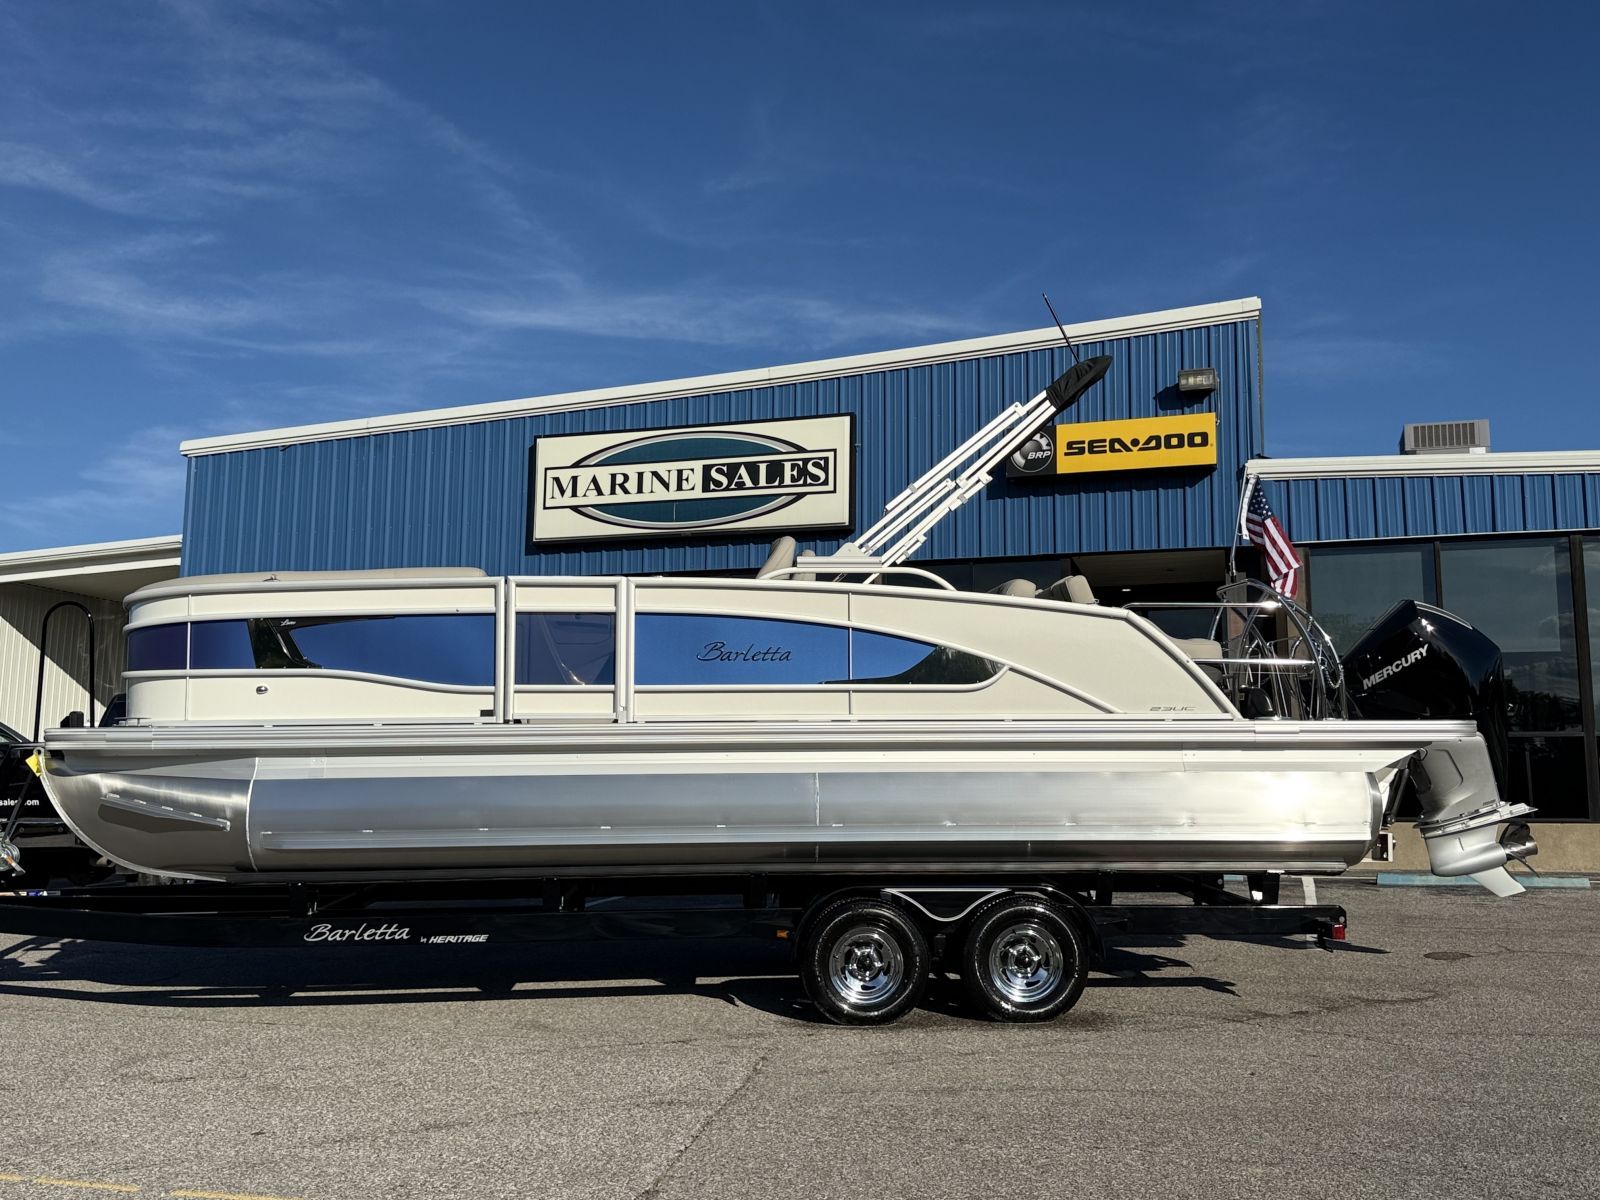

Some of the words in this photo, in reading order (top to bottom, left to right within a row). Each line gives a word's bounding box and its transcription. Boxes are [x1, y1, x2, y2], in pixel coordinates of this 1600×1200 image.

[1027, 450, 1051, 460] BRP
[550, 467, 697, 500] MARINE
[709, 458, 827, 491] SALES
[696, 641, 792, 662] Barletta
[1362, 643, 1429, 691] MERCURY
[303, 922, 411, 942] Barletta
[428, 934, 490, 944] HERITAGE
